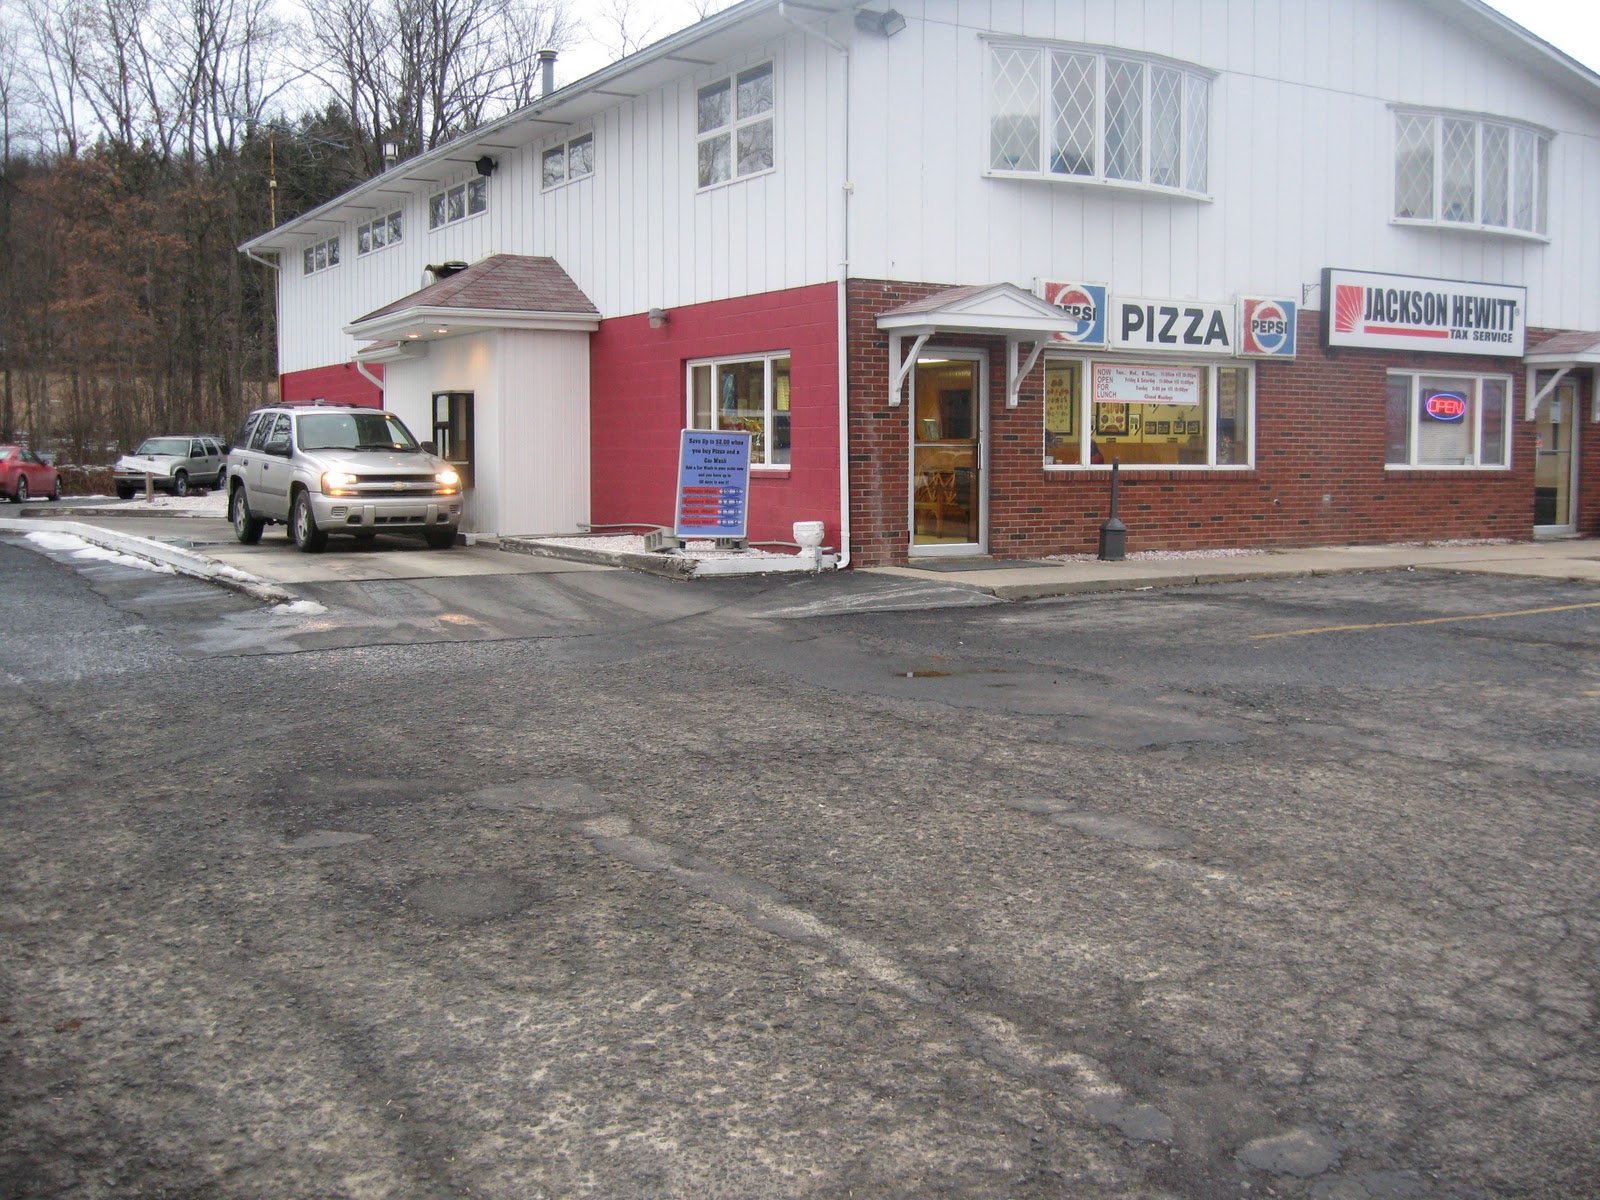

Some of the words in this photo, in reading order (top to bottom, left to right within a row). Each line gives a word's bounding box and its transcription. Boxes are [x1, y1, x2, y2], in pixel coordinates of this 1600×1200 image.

[1364, 287, 1448, 327] JACKSON
[1452, 294, 1517, 332] HEWITT
[1121, 304, 1230, 346] PIZZA
[1252, 319, 1288, 334] PEPSI
[1450, 328, 1468, 340] TAX
[1473, 330, 1512, 344] SERVICE
[1429, 400, 1464, 414] OPEN
